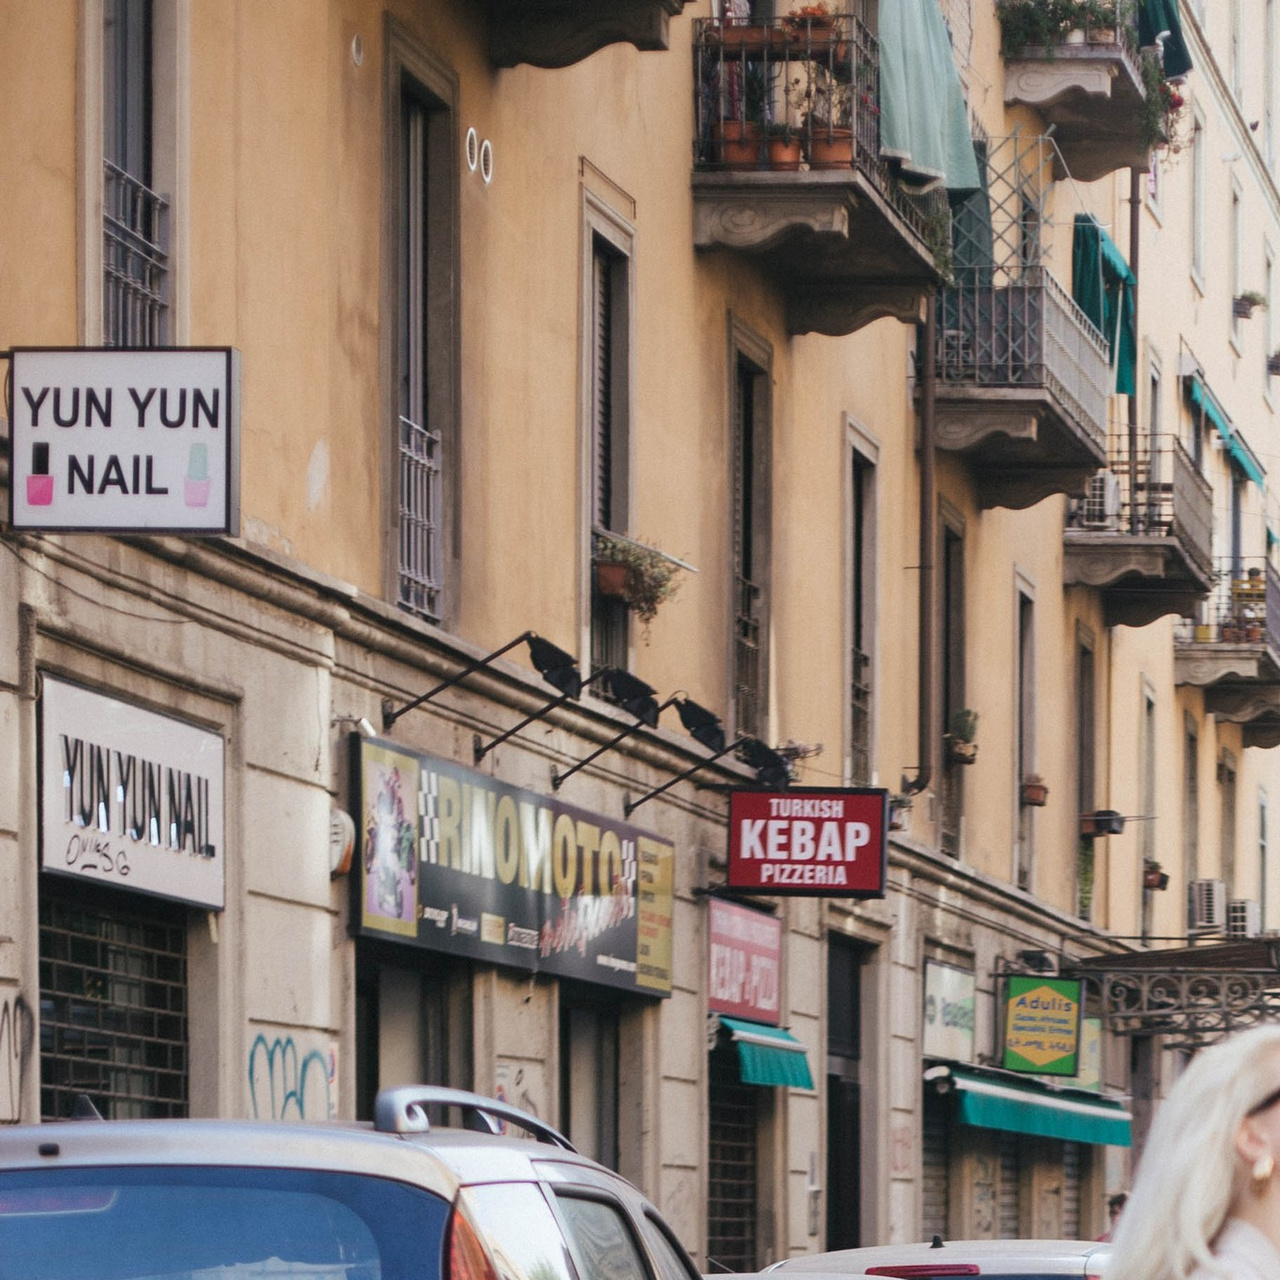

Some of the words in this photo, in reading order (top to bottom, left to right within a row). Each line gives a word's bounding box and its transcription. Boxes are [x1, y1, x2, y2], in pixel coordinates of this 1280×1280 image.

[21, 387, 112, 428] YUN
[128, 387, 219, 429] YUN
[68, 454, 169, 495] NAIL
[60, 734, 110, 834] YUN
[114, 750, 161, 847] YUN
[166, 766, 216, 859] NAIL
[769, 798, 845, 819] TURKISH
[438, 775, 623, 900] RINOMOTO
[740, 819, 871, 862] KEBAP
[760, 863, 848, 885] PIZZERIA
[1016, 996, 1072, 1012] Adulis
